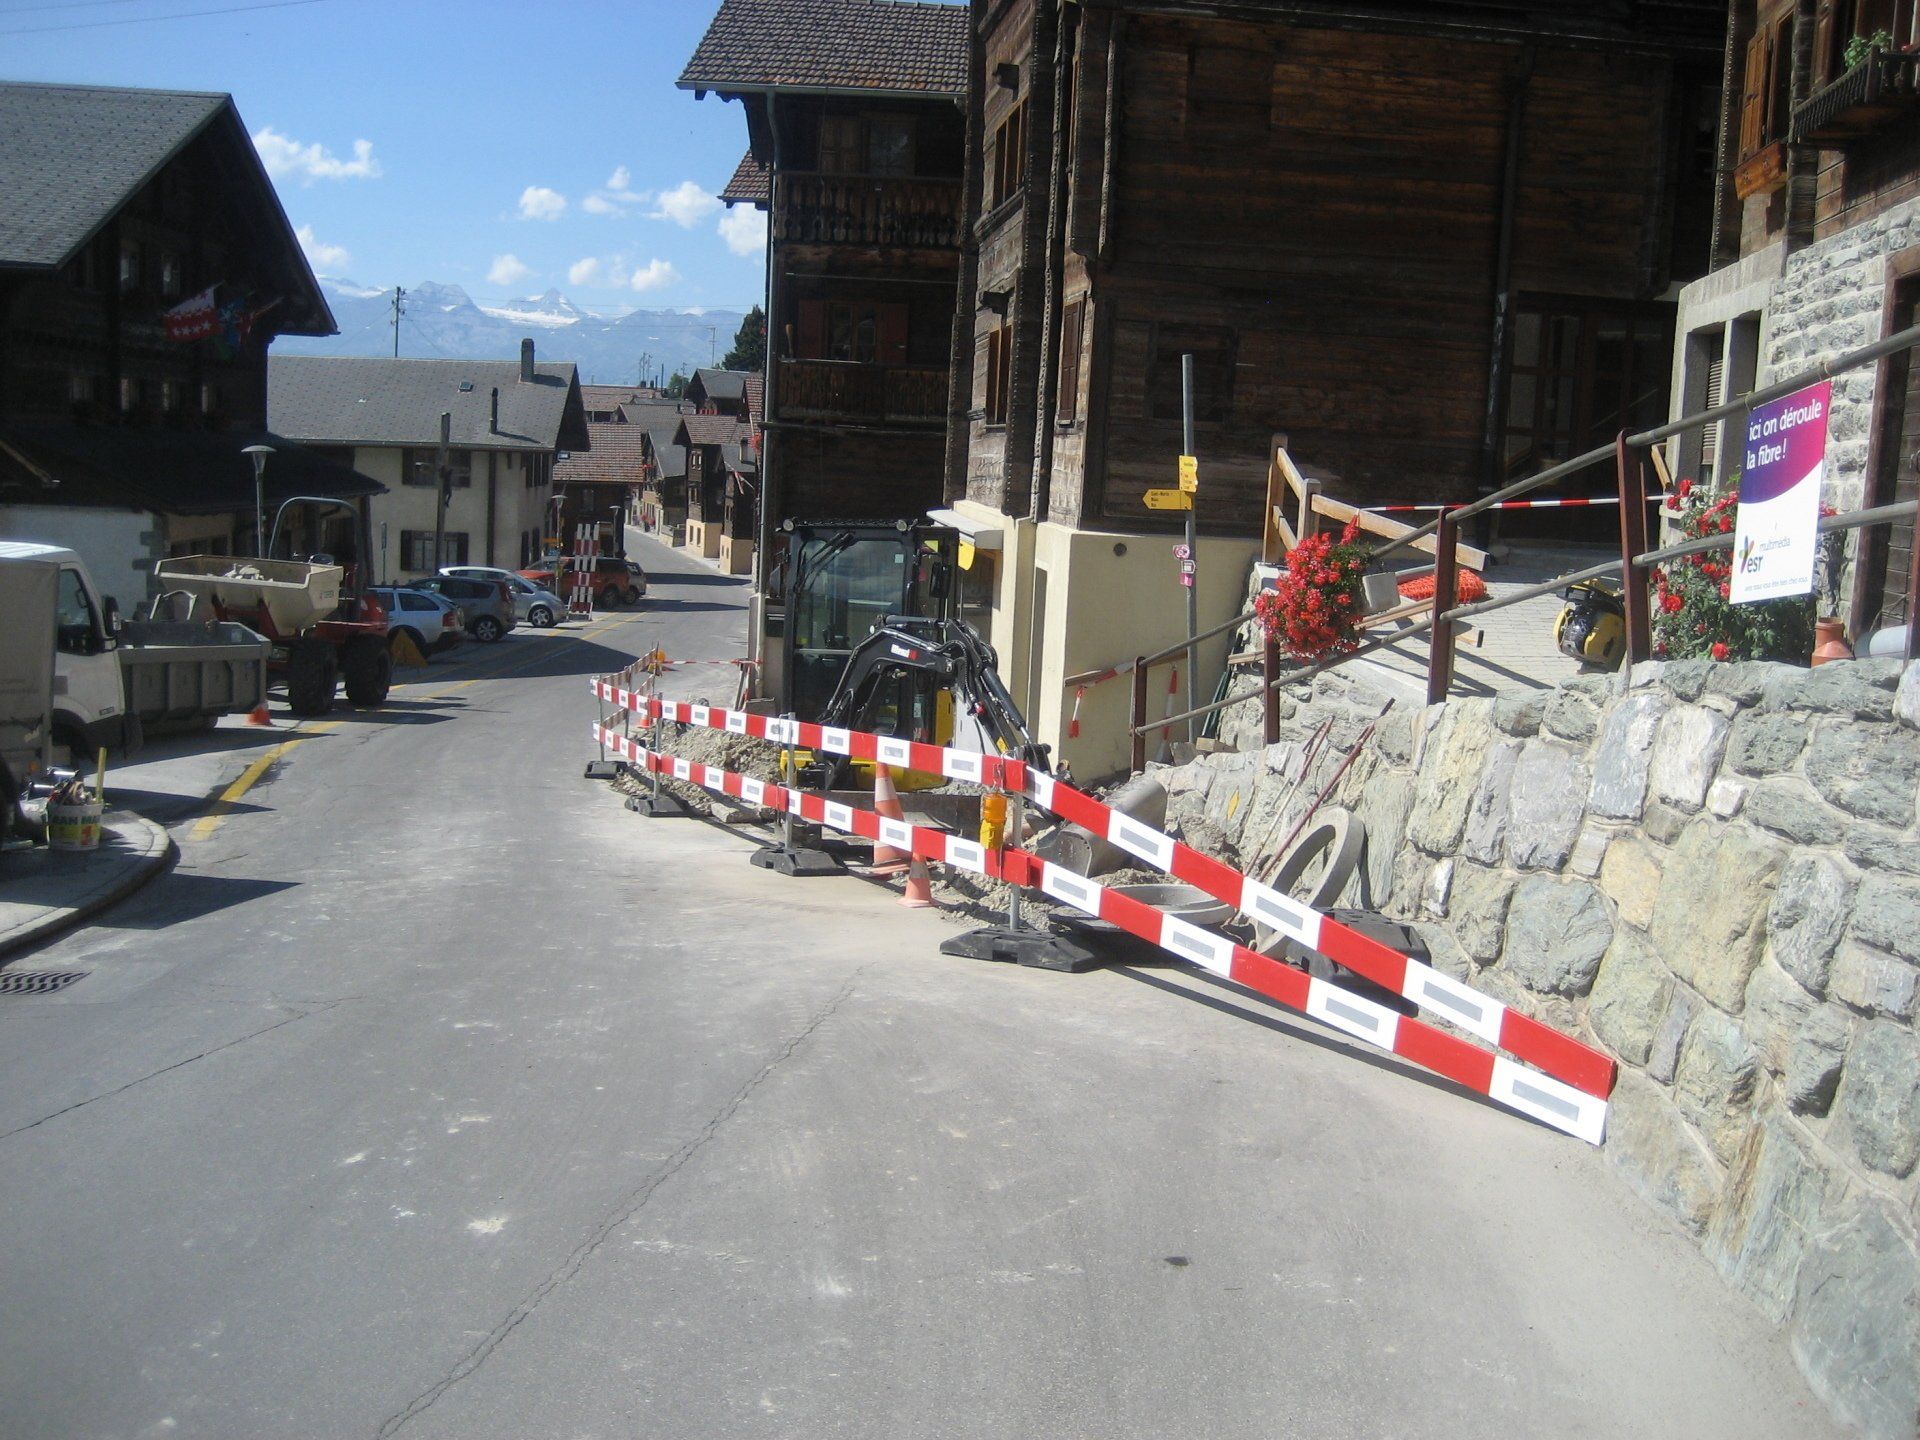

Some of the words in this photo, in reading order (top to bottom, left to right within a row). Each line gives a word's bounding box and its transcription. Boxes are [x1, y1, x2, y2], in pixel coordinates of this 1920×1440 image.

[1749, 419, 1761, 441] ici
[1763, 418, 1777, 436] on
[1779, 399, 1822, 431] déroule
[1746, 450, 1755, 470] la
[1758, 444, 1782, 466] fibre
